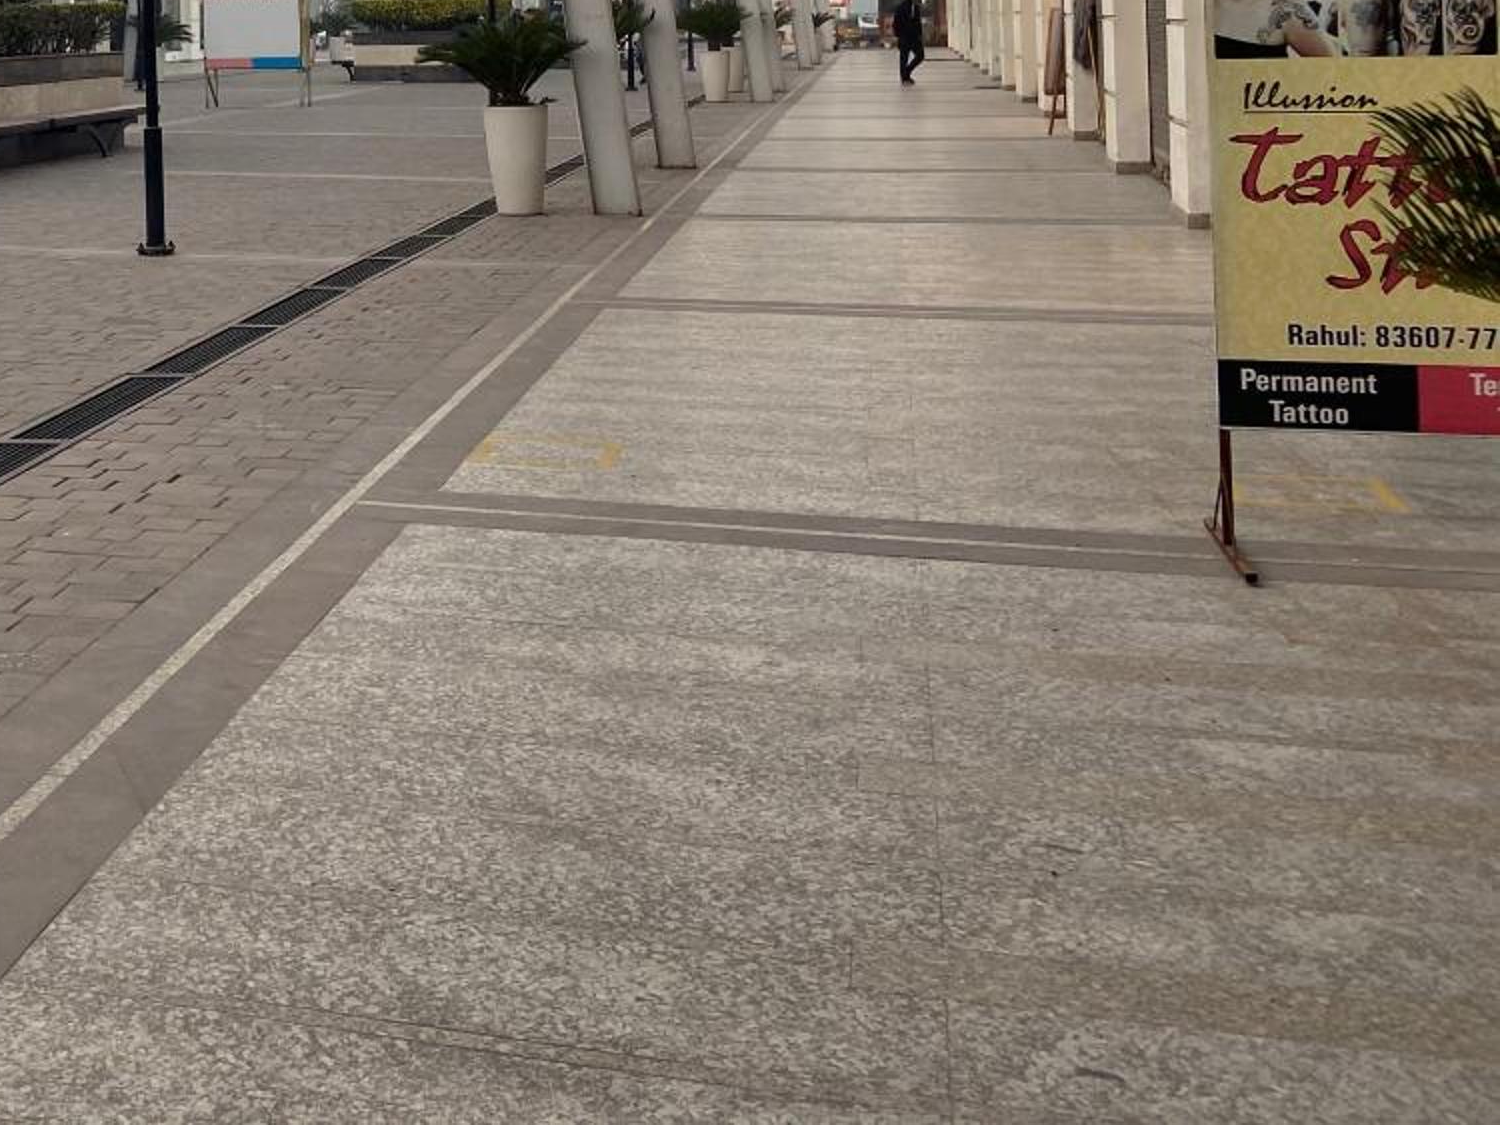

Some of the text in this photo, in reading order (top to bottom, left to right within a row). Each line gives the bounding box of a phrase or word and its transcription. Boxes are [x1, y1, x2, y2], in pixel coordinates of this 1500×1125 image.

[1287, 324, 1498, 350] Rahul: 83607-77
[1239, 367, 1378, 395] Permanent
[1469, 372, 1500, 397] Te
[1268, 399, 1349, 425] Tattoo
